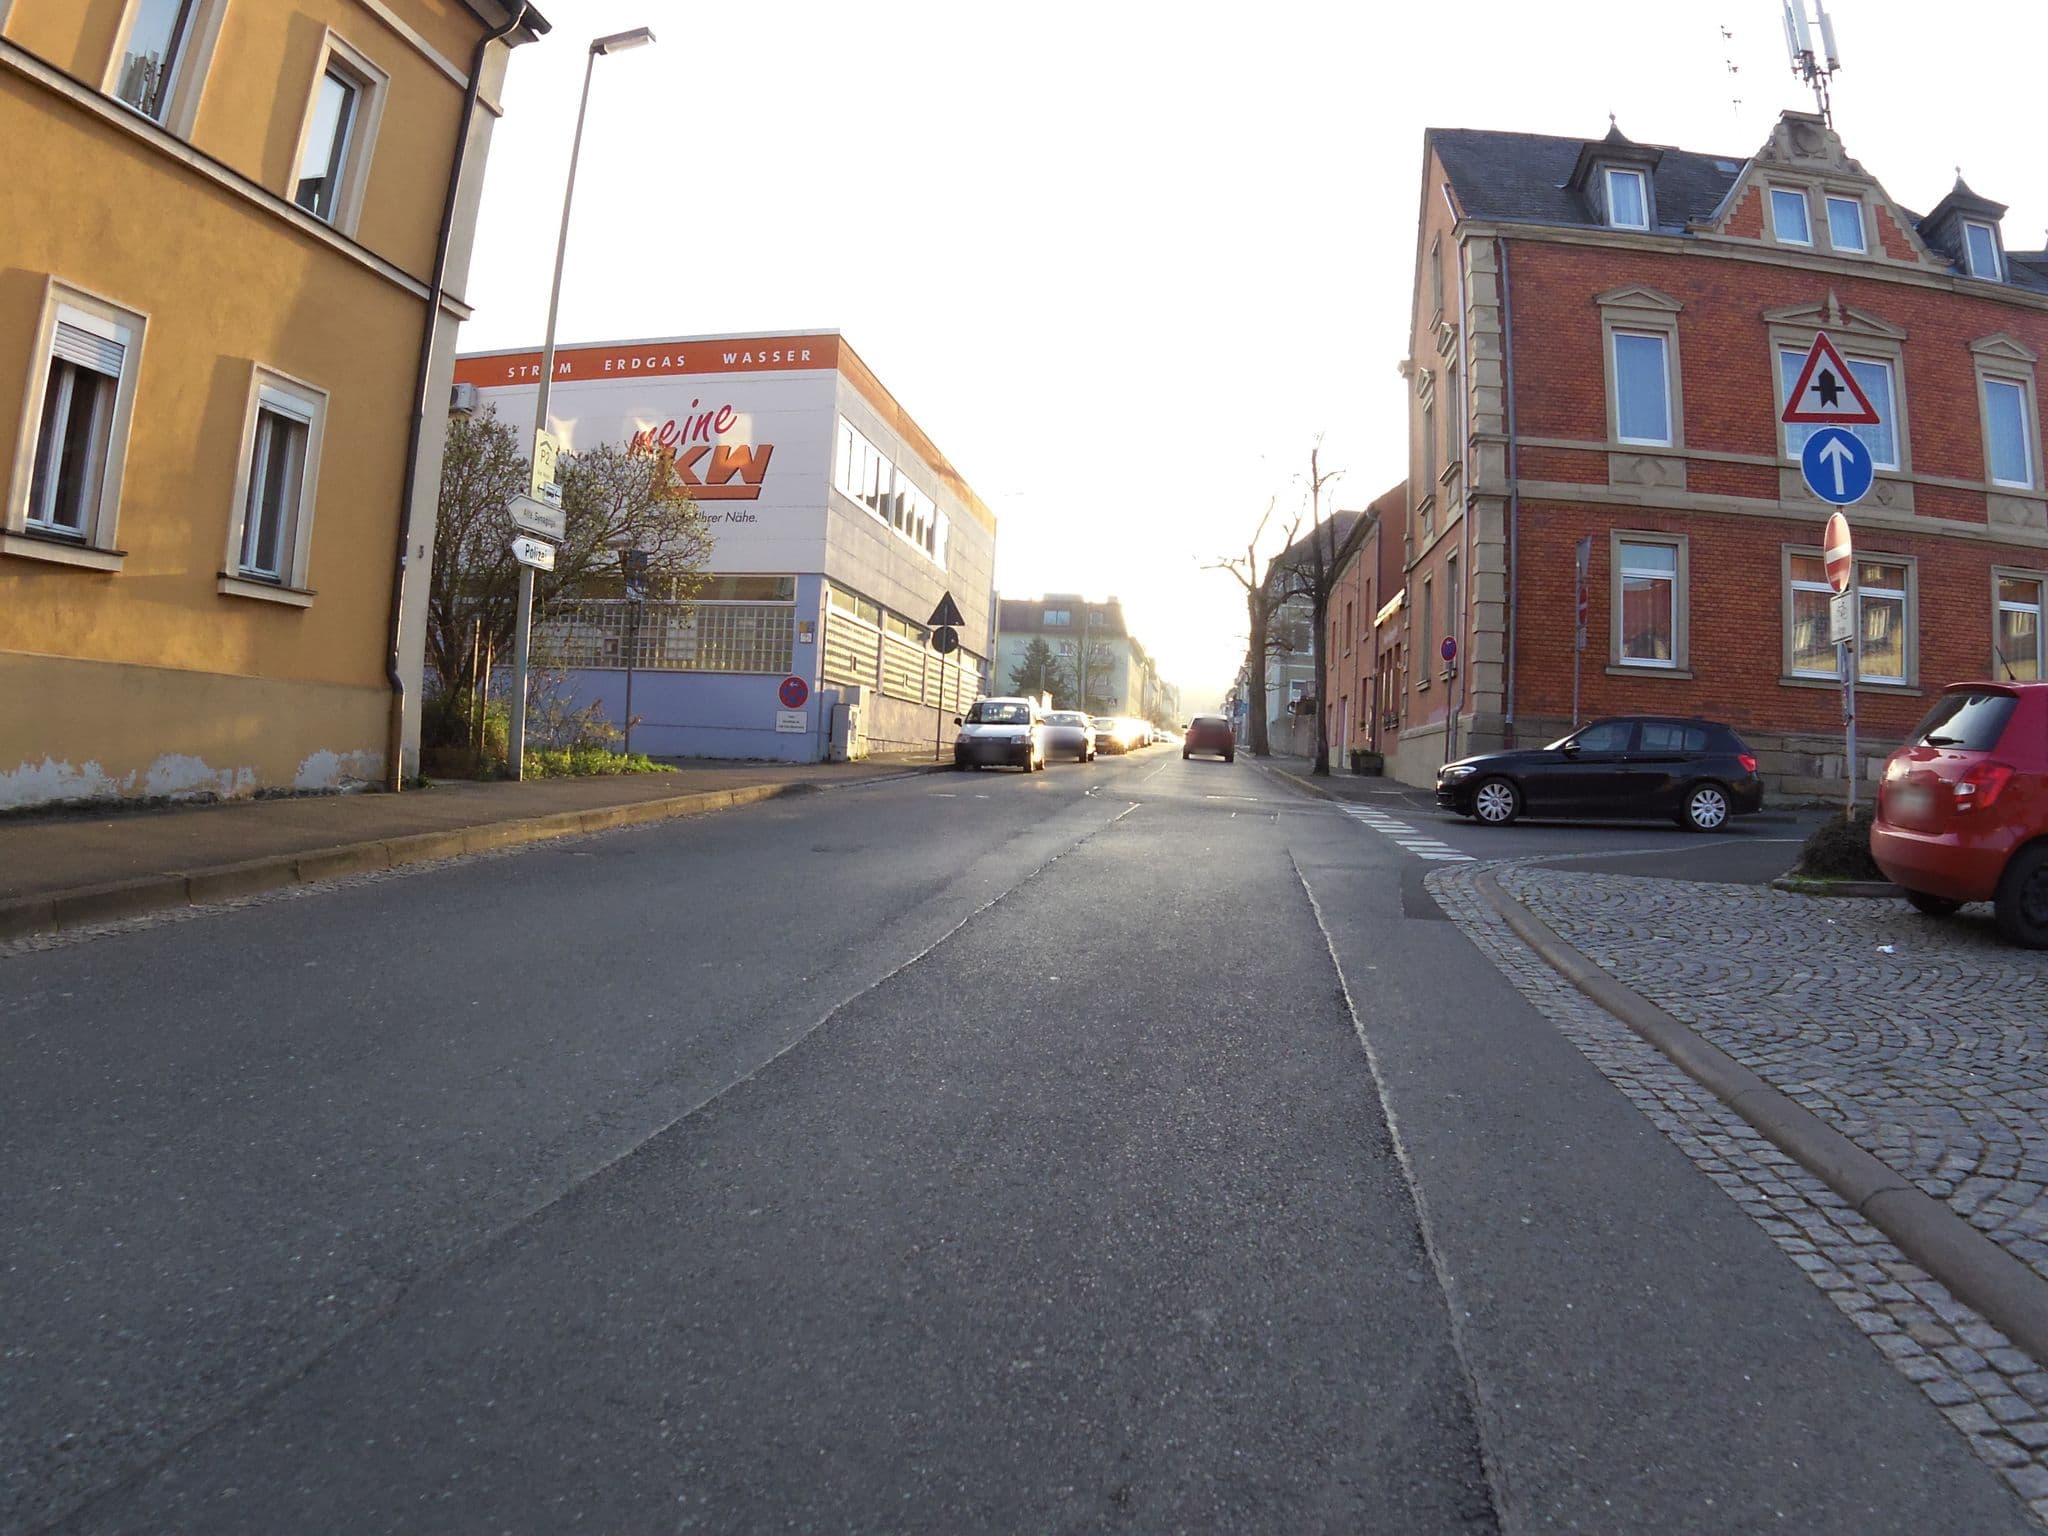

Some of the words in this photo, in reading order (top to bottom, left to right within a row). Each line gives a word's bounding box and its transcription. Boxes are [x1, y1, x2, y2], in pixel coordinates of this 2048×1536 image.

[507, 362, 572, 378] STRM
[604, 355, 685, 371] ERDGAS
[722, 350, 811, 364] WASSER
[627, 398, 738, 460] meine
[540, 449, 550, 466] P2
[725, 509, 758, 523] Nähe.
